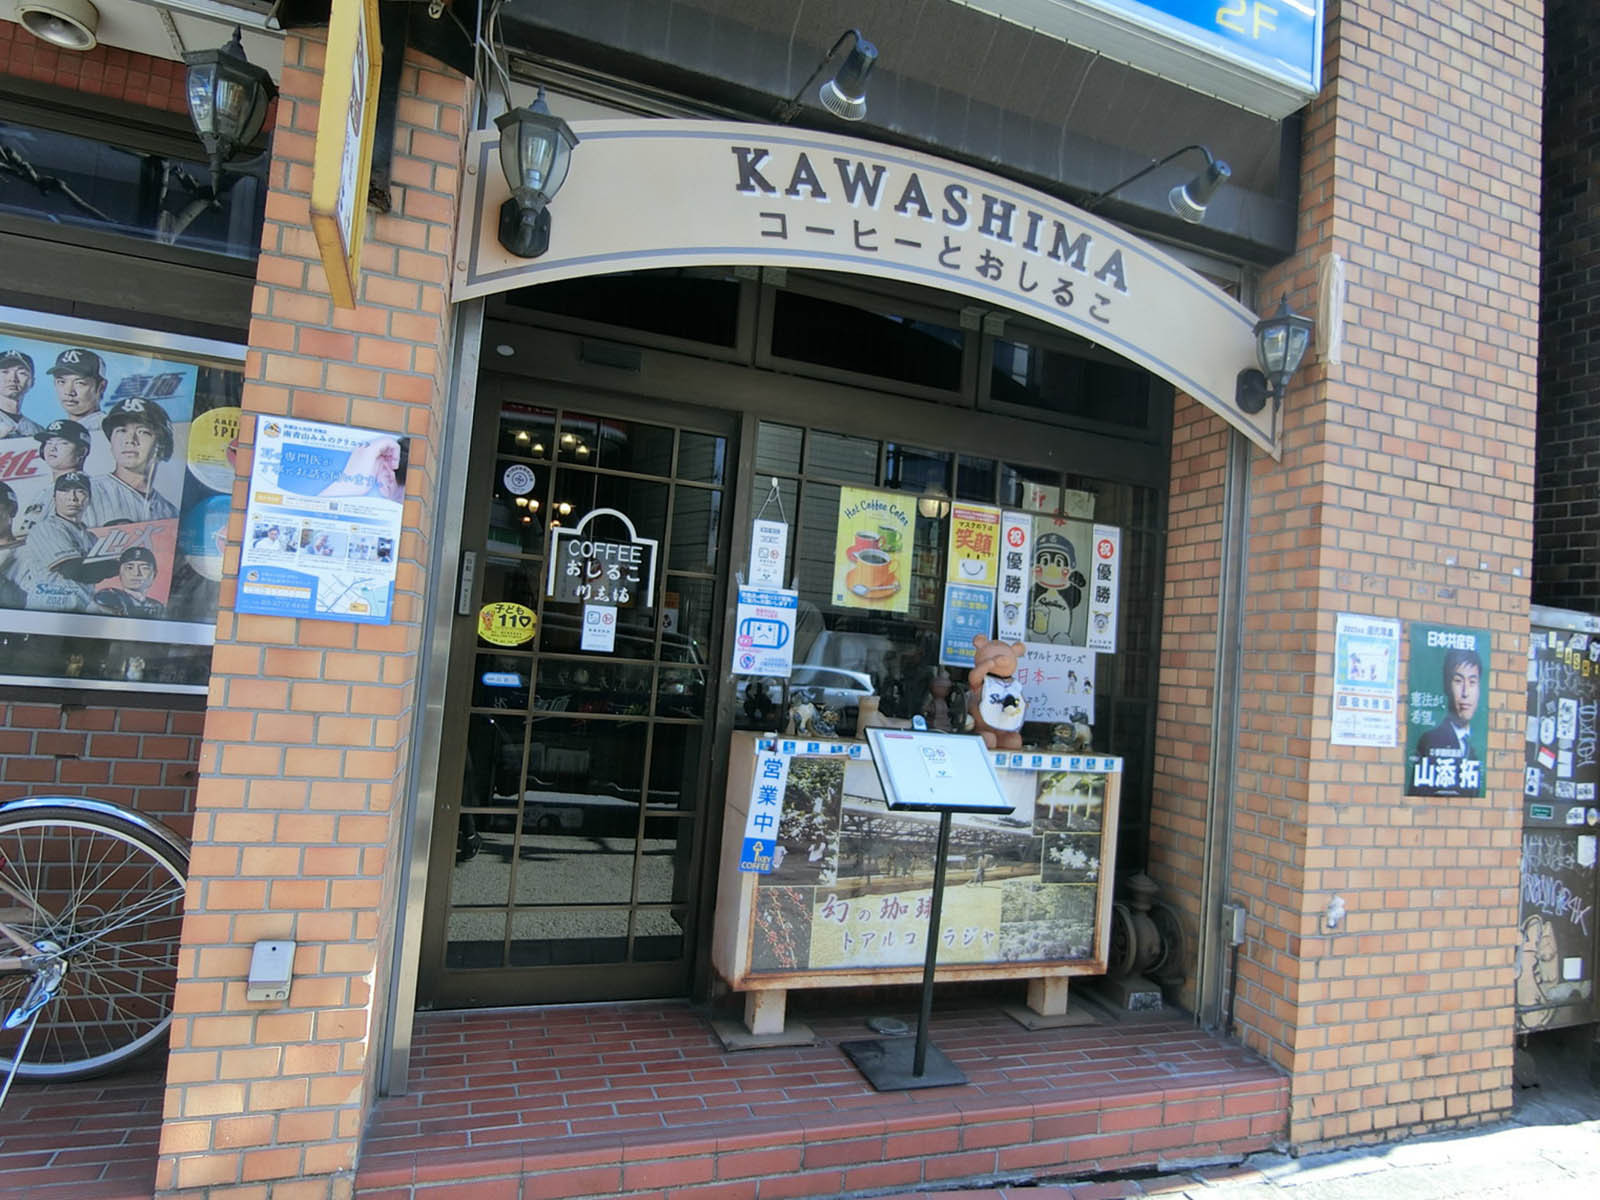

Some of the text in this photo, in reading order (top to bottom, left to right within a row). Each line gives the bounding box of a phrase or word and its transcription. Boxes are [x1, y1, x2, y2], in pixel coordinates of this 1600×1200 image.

[1215, 0, 1279, 39] 2F
[731, 146, 1129, 294] KAWASHIMA
[759, 211, 1111, 325] コーヒーとおしるこ
[844, 505, 860, 520] Hot
[860, 499, 888, 514] Coffee
[568, 539, 644, 564] COFFEE
[956, 528, 993, 553] 笑顔
[566, 559, 641, 583] おしるこ
[495, 603, 525, 616] 子ども
[1427, 631, 1476, 651] 日本共産党
[1027, 650, 1052, 662] ヤクルト
[1017, 667, 1062, 686] 日本一
[1414, 757, 1481, 788] 山添拓
[753, 757, 783, 833] 営業中
[741, 861, 770, 871] COFFEE
[843, 927, 995, 950] トアルコラジャ
